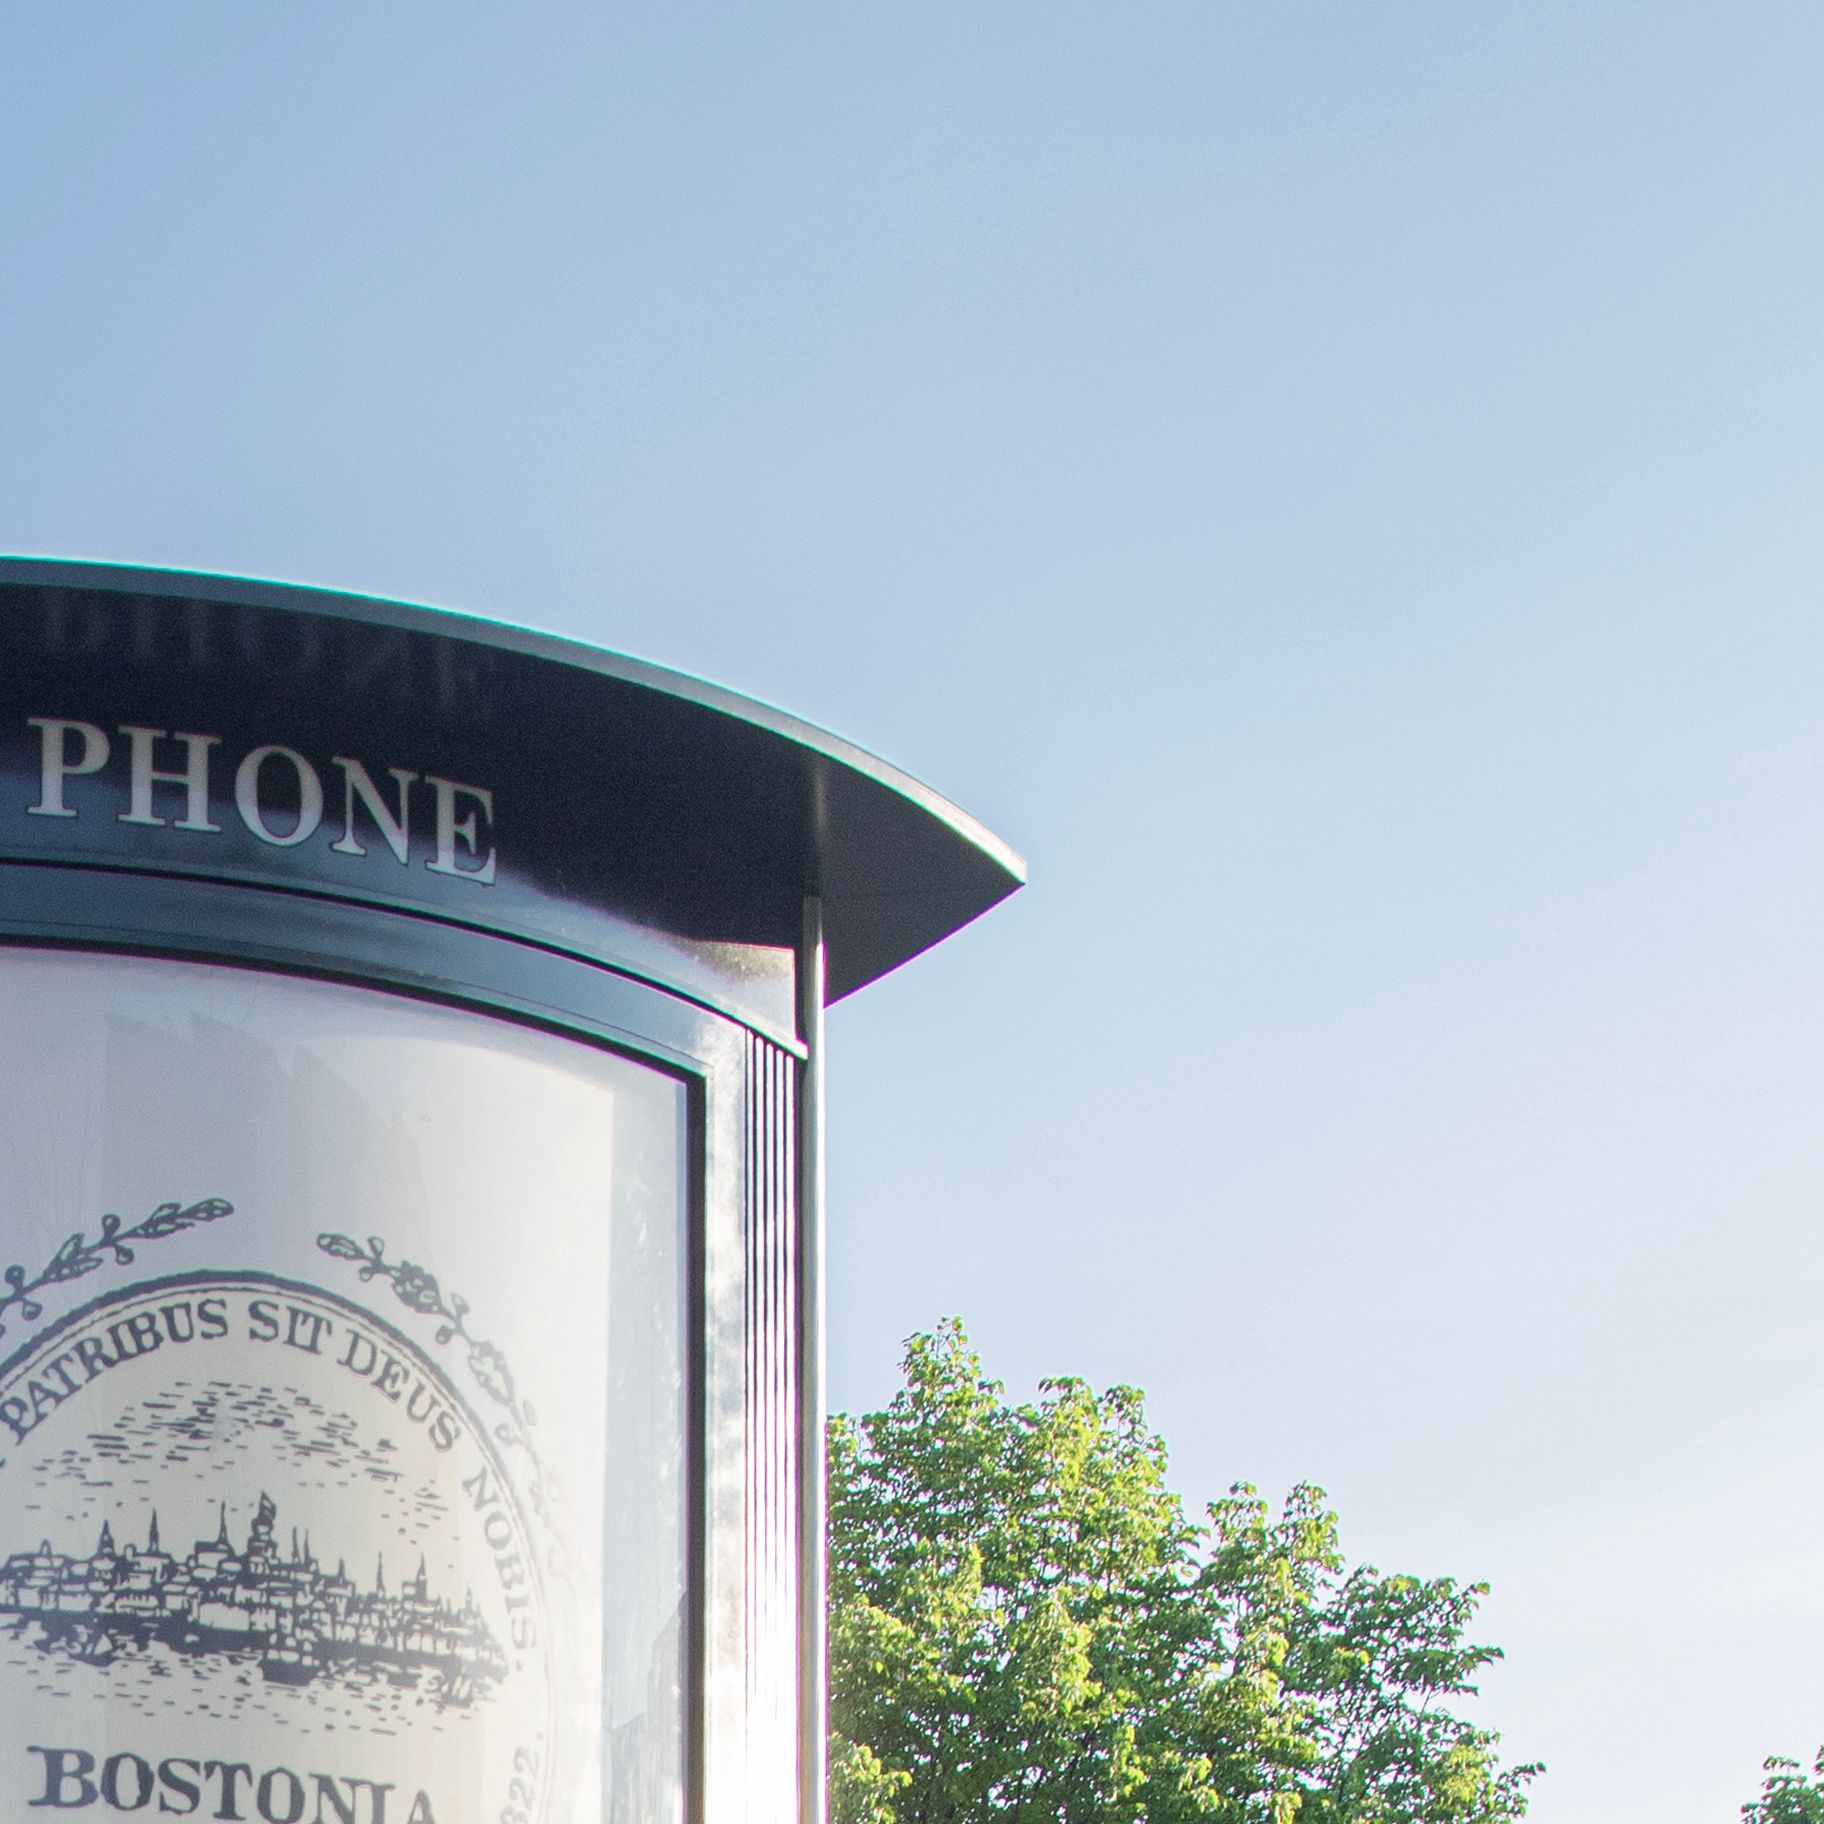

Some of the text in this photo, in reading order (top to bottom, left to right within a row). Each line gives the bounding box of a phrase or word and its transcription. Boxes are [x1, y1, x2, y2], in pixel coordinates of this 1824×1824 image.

[26, 717, 496, 886] PHONE
[248, 1299, 332, 1356] SIT
[336, 1328, 461, 1452] DEUS
